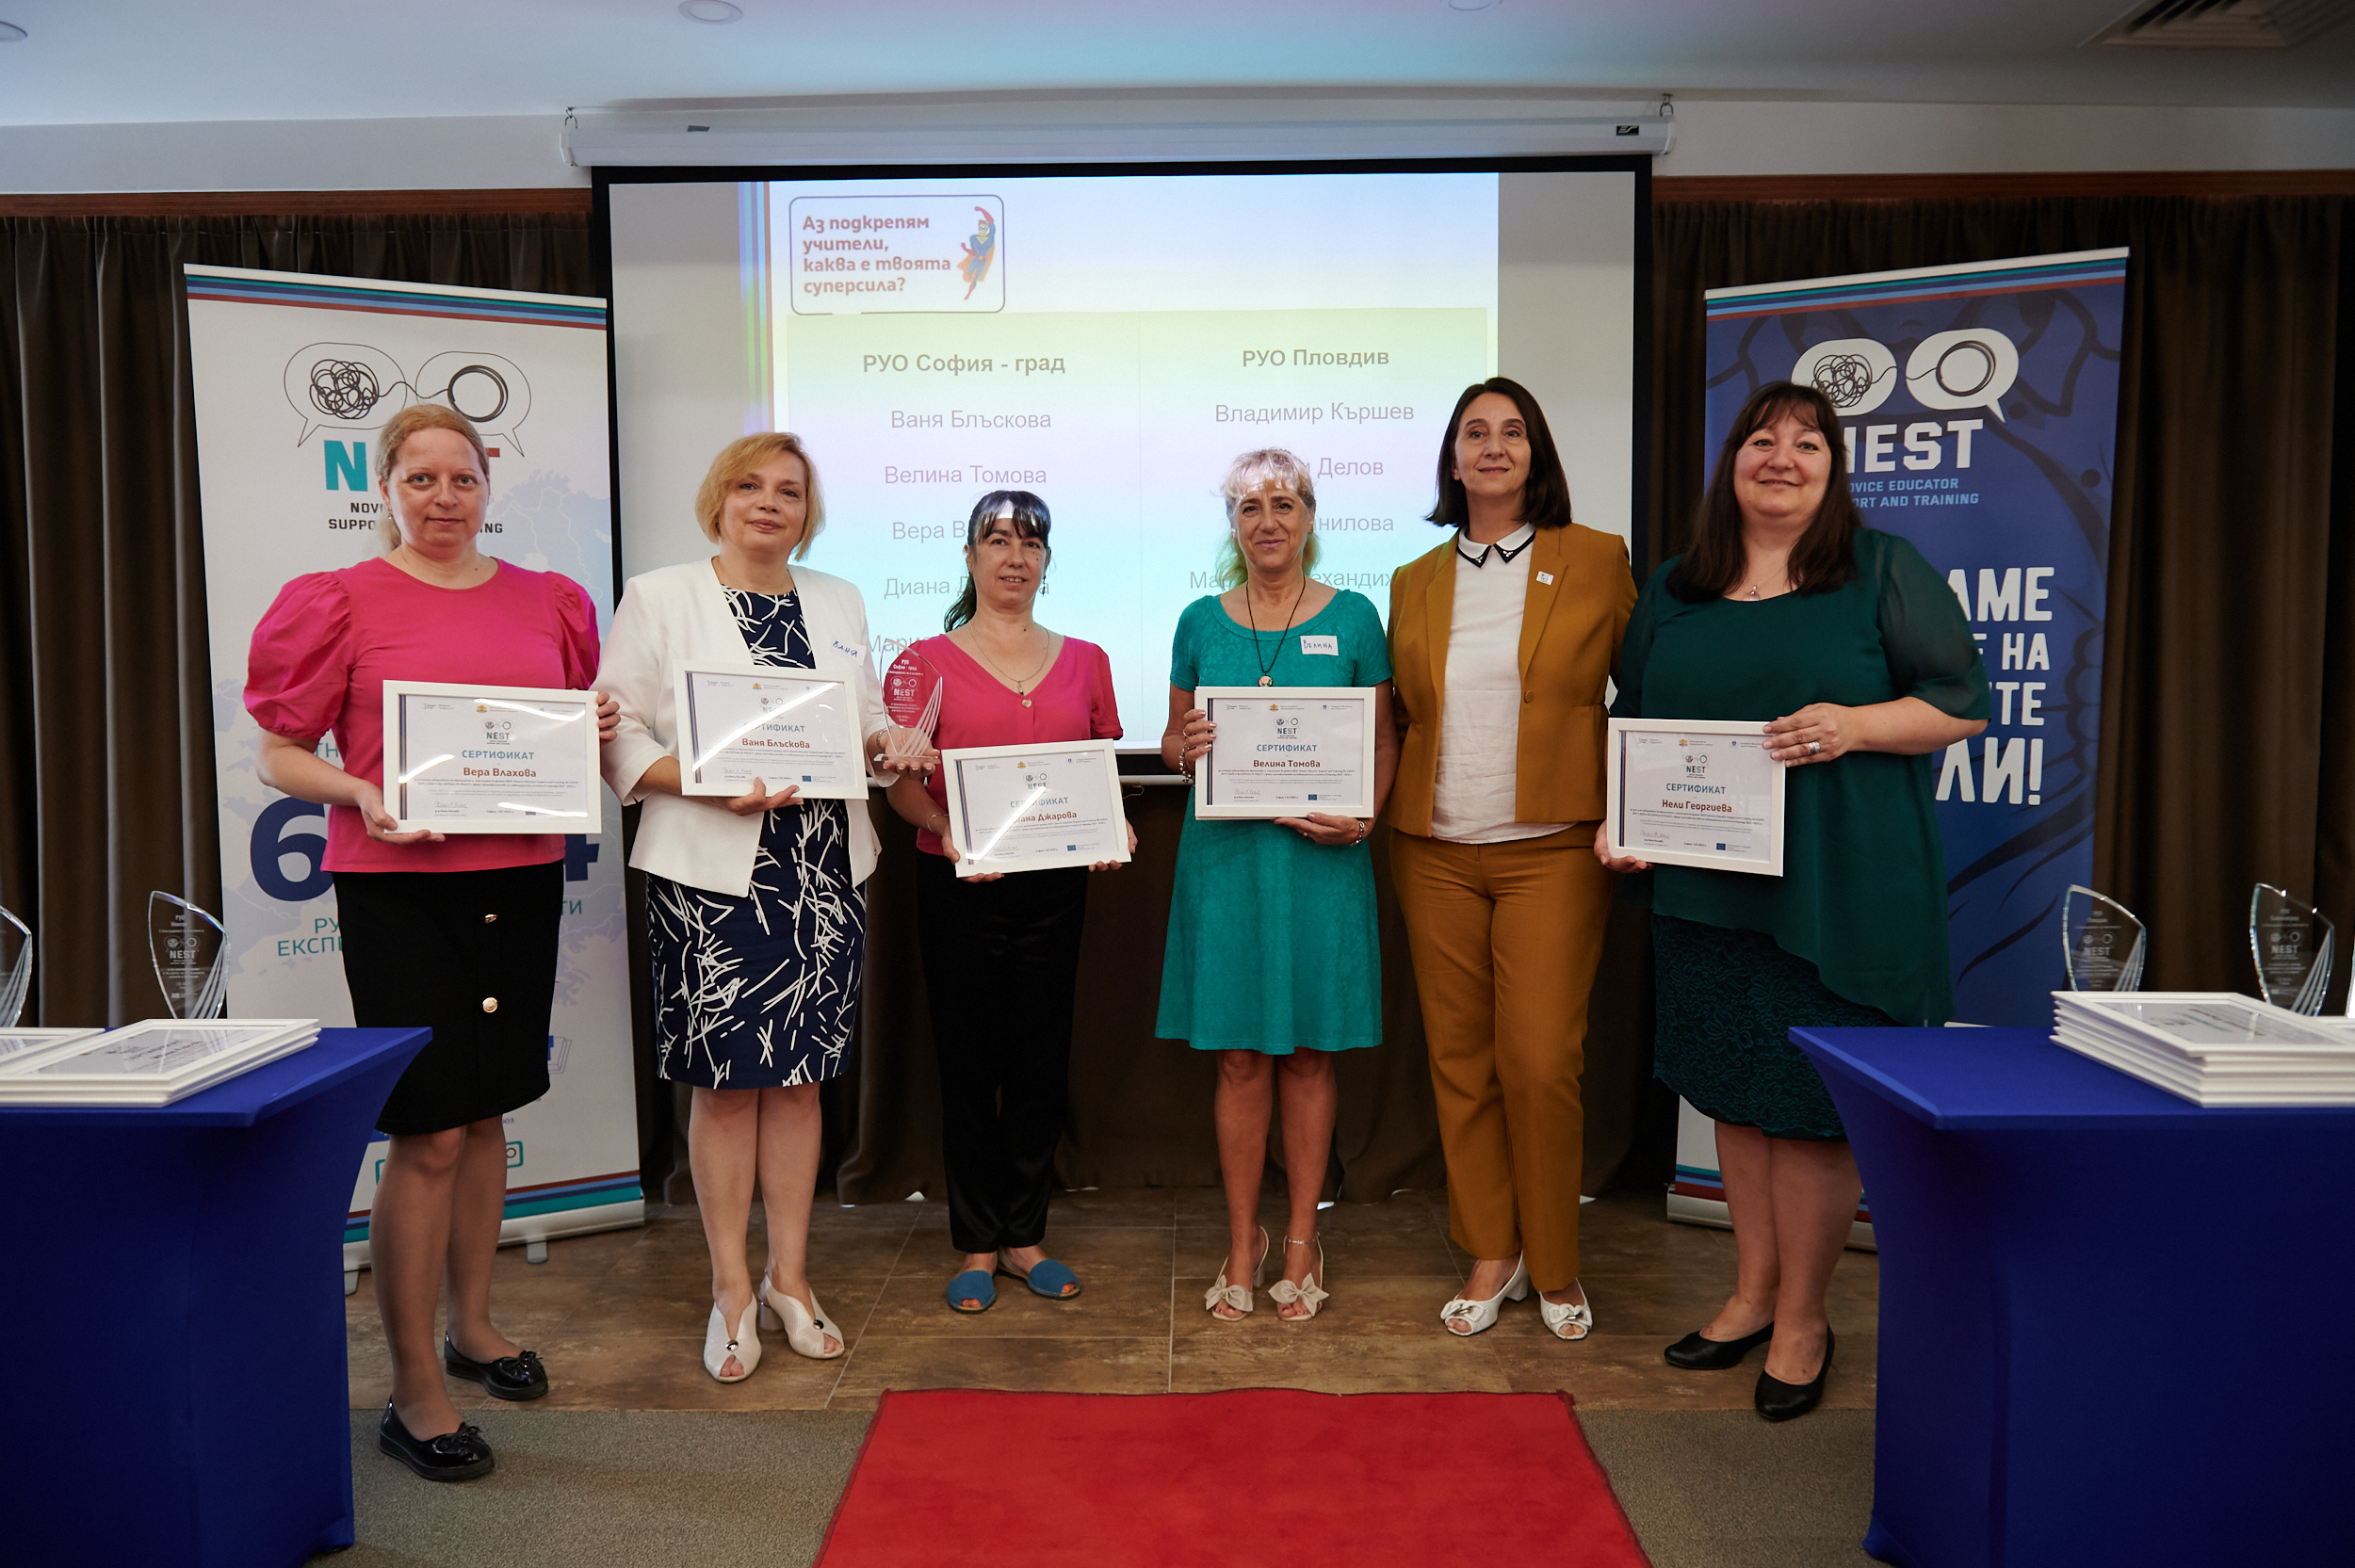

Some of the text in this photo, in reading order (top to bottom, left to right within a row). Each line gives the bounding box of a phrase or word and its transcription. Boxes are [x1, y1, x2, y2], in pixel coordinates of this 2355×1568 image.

[803, 215, 930, 234] Аз подкрепям
[803, 238, 889, 255] учители,
[804, 256, 951, 272] каква е твоята
[804, 277, 906, 297] суперсила?
[863, 354, 909, 372] РУО
[916, 353, 993, 376] София
[1015, 357, 1066, 377] град
[1242, 348, 1389, 368] РУО Пловдив
[891, 410, 1052, 428] Ваня Блъскова
[1215, 402, 1415, 425] Владимир Кършев
[885, 464, 1048, 484] Велина Томова
[1317, 457, 1385, 479] Делов
[1888, 477, 1960, 492] EDUCATOR
[1879, 495, 1909, 509] AND
[1913, 493, 1980, 507] TRAINING
[892, 521, 945, 543] Вера
[1314, 517, 1395, 532] нилова
[884, 577, 950, 600] Диана
[2001, 633, 2051, 671] НА
[893, 688, 916, 697] NEST
[486, 732, 511, 740] NEST
[741, 737, 810, 749] Ваня Блъскова
[462, 750, 535, 760] СЕРТИФИКАТ
[1253, 759, 1321, 768] Велина Томова
[1685, 765, 1706, 773] NEST
[463, 767, 537, 778] Вера Влахова
[1665, 783, 1727, 795] СЕРТИФИКАТ
[1662, 799, 1732, 813] Нели Георгиева
[1037, 811, 1078, 822] Джарова
[170, 950, 196, 959] NEST
[2271, 945, 2298, 954] NEST
